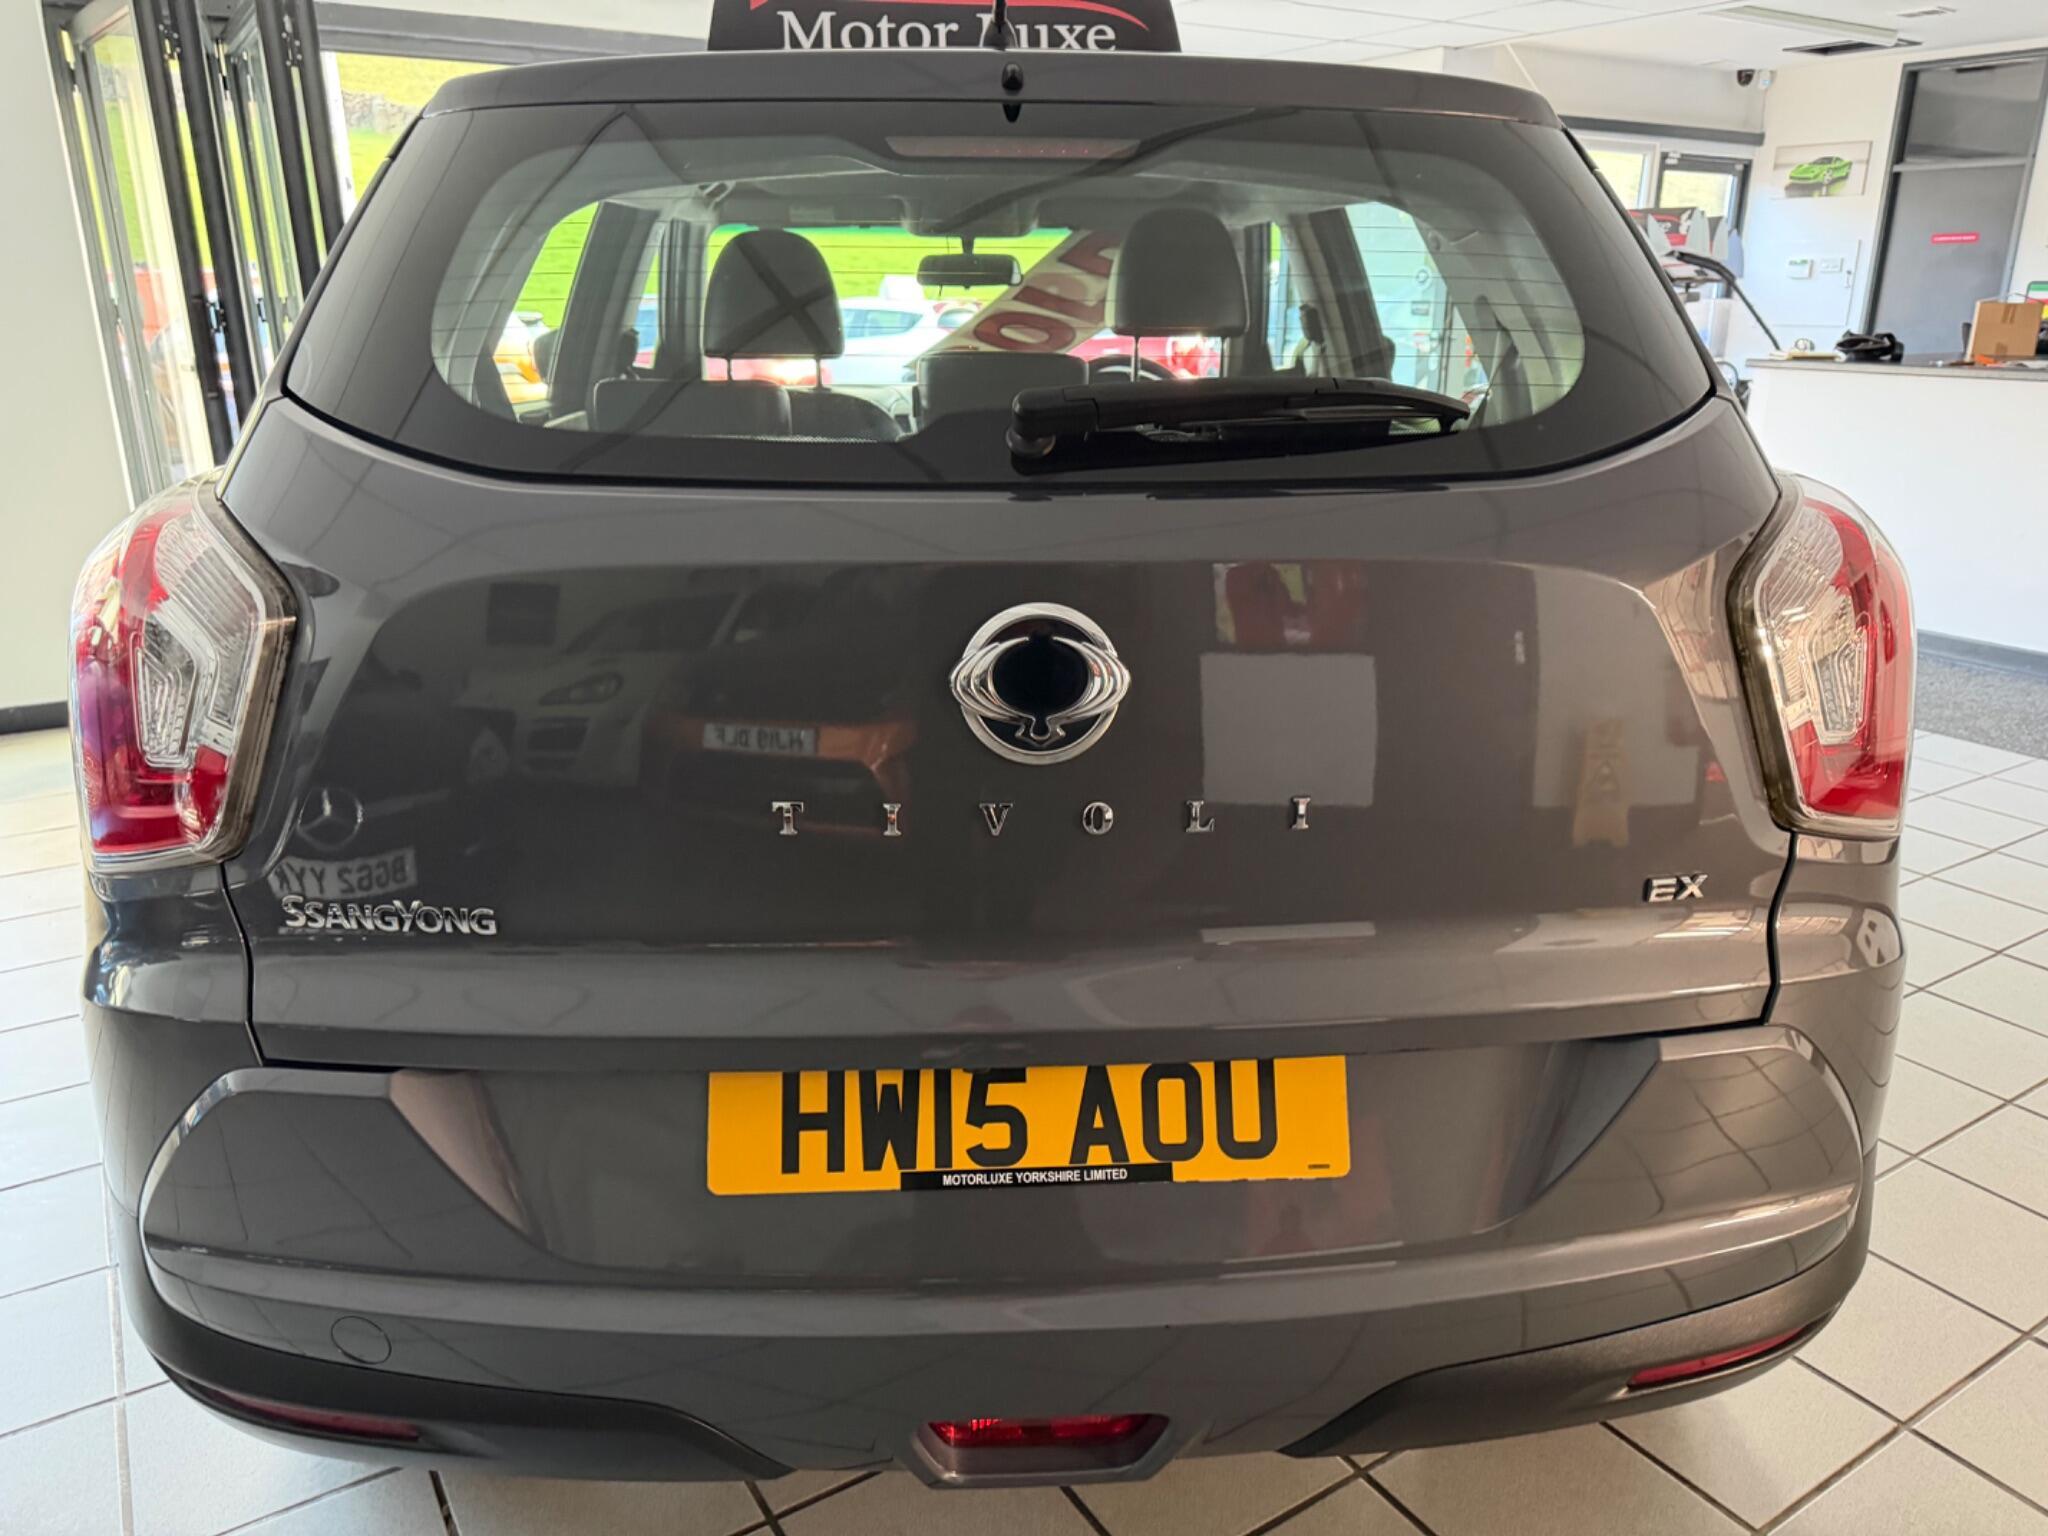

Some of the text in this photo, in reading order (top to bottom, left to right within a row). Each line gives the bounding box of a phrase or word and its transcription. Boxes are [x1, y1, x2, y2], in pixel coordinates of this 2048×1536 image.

[777, 11, 957, 49] Motor
[771, 797, 1311, 837] TIVOLI
[1642, 873, 1709, 902] EX
[781, 1058, 1278, 1175] HW15 AOU
[942, 1167, 1129, 1187] MOTORLUXE YORKSHIRE LIMITED
